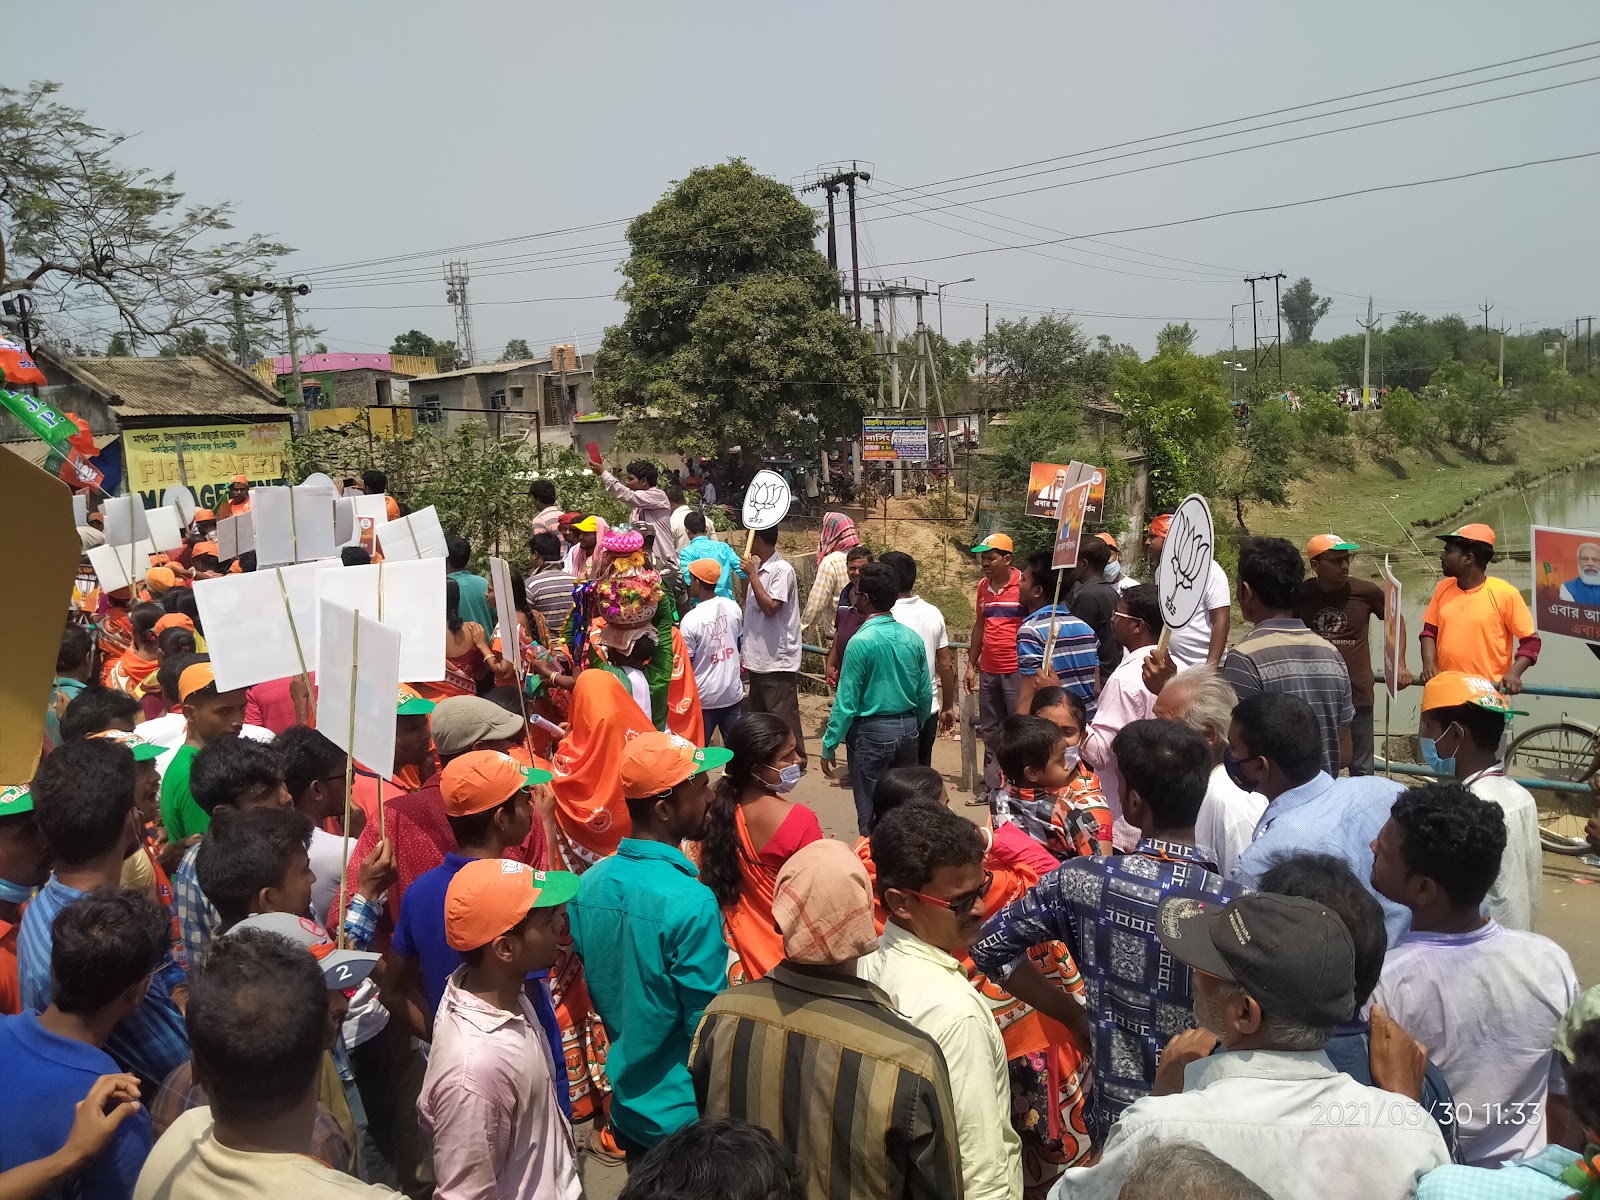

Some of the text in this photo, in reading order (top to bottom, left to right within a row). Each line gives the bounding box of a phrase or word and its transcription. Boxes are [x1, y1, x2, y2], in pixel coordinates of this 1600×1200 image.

[140, 451, 284, 483] FIRE SAFET
[1549, 604, 1579, 619] এবার
[710, 646, 735, 665] BJP
[335, 964, 353, 982] 2
